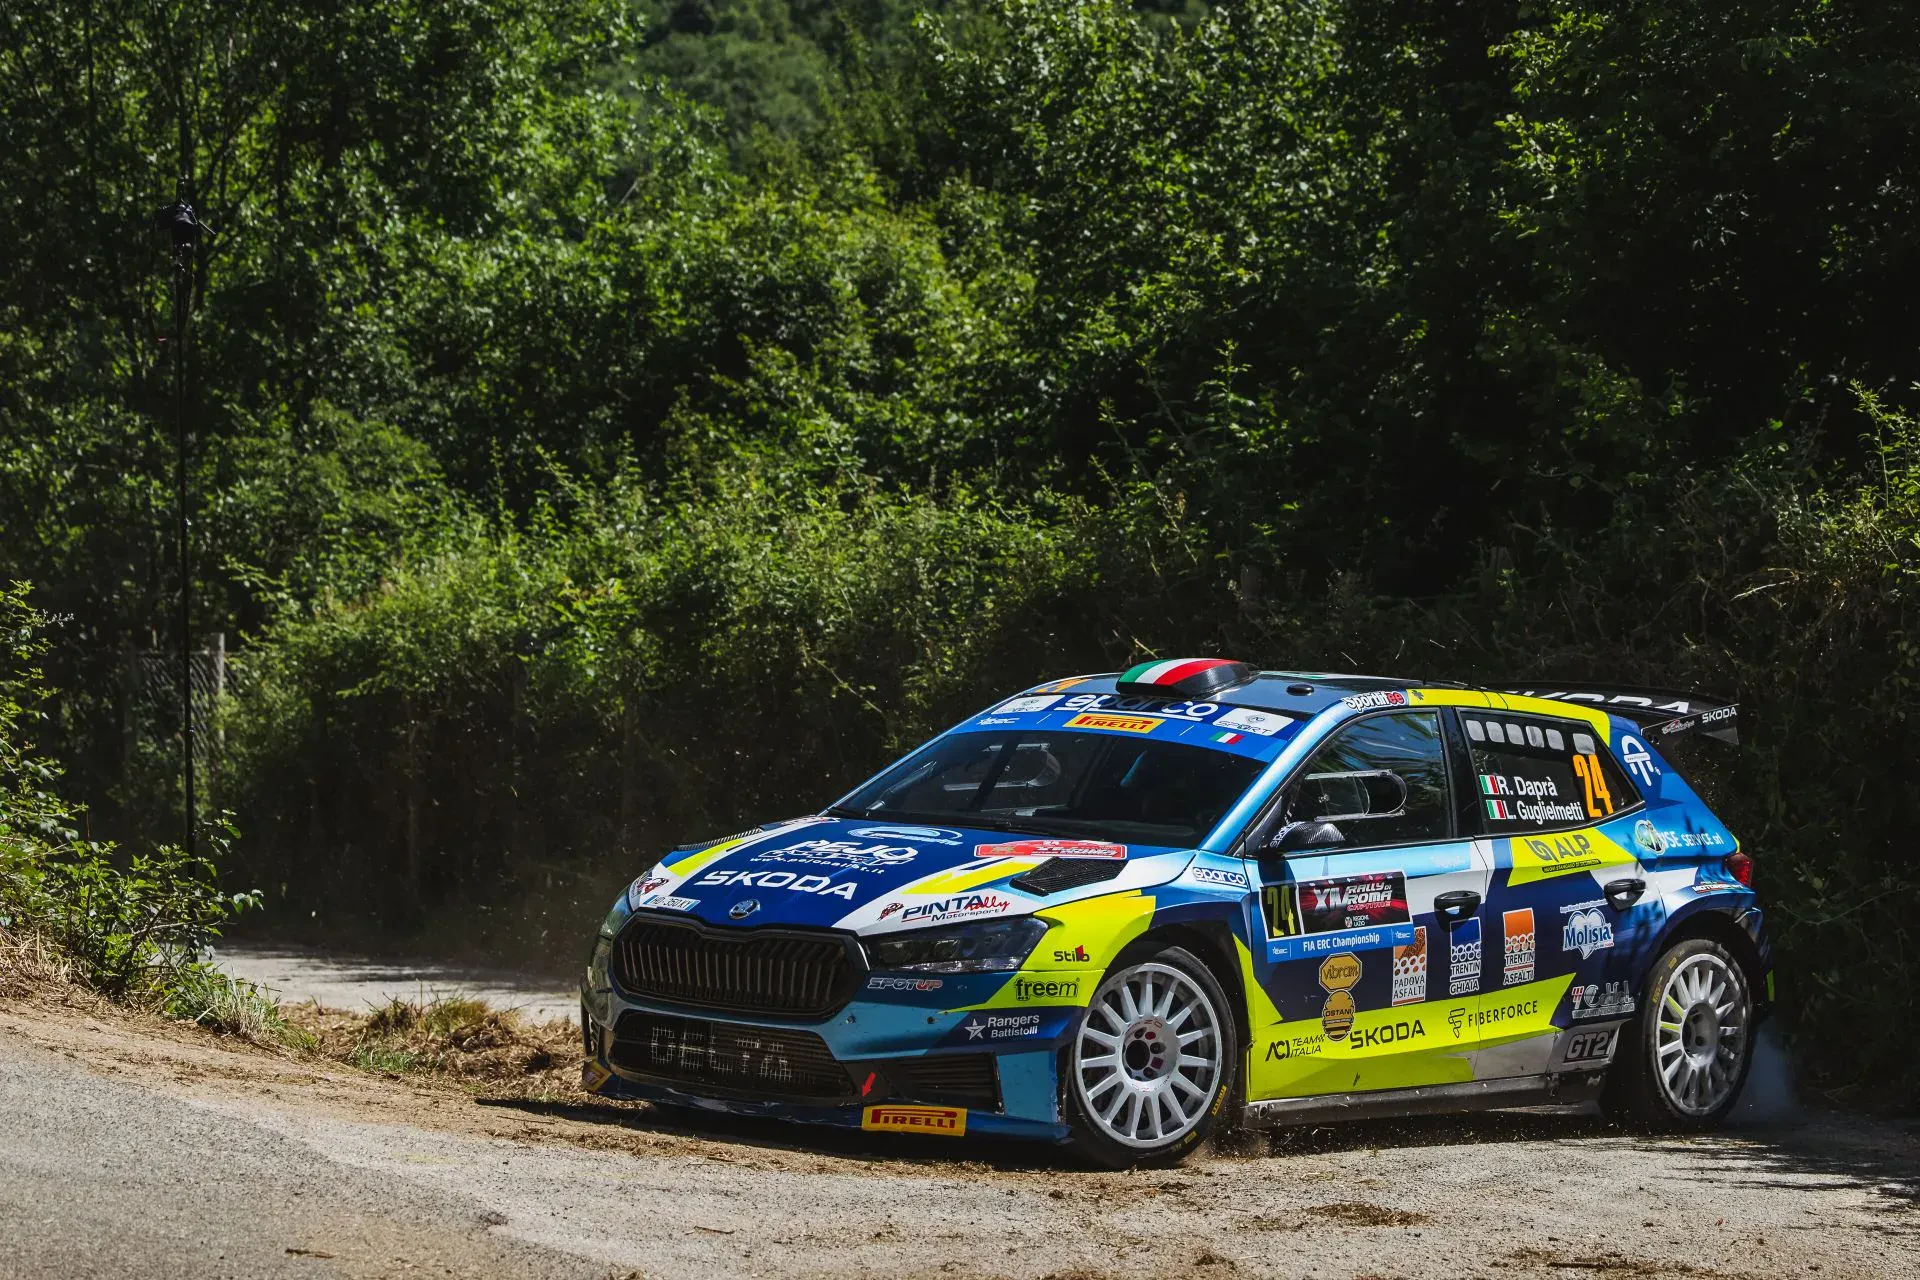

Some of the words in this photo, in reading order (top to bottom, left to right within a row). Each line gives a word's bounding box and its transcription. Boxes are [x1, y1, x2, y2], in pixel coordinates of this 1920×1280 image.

[1074, 714, 1155, 730] PIRELLI
[1702, 707, 1738, 724] SKODA
[1496, 775, 1514, 796] R.
[1514, 775, 1558, 801] Daprà
[1571, 753, 1614, 818] 24
[1504, 800, 1517, 820] L.
[1517, 800, 1585, 825] Guglielmetti
[793, 839, 918, 861] PEJO
[1554, 834, 1591, 859] ALP
[1192, 866, 1249, 887] sparco
[693, 870, 858, 900] SKODA
[1346, 881, 1385, 894] RALLY
[1346, 889, 1393, 905] ROMA
[931, 908, 1000, 922] Motorsport
[1266, 885, 1296, 937] 24
[1303, 940, 1316, 952] FIA
[1317, 938, 1332, 951] ERC
[1332, 932, 1381, 949] Championship
[1505, 951, 1535, 966] TRENTIN
[1450, 960, 1481, 976] TRENTIN
[1393, 974, 1426, 989] PADOVA
[1503, 969, 1535, 985] ASFALTI
[1392, 985, 1425, 1000] ASFALTI
[1450, 979, 1480, 994] GHIAIA
[987, 1014, 1041, 1028] Rangers
[1467, 999, 1538, 1028] FIBERFORCE
[990, 1025, 1039, 1039] Battistolli
[1350, 1019, 1426, 1050] SKODA
[1292, 1035, 1321, 1047] TEAM
[1567, 1030, 1610, 1059] GT2
[1290, 1044, 1322, 1059] ITALIA
[871, 1108, 958, 1129] PIRELLI
